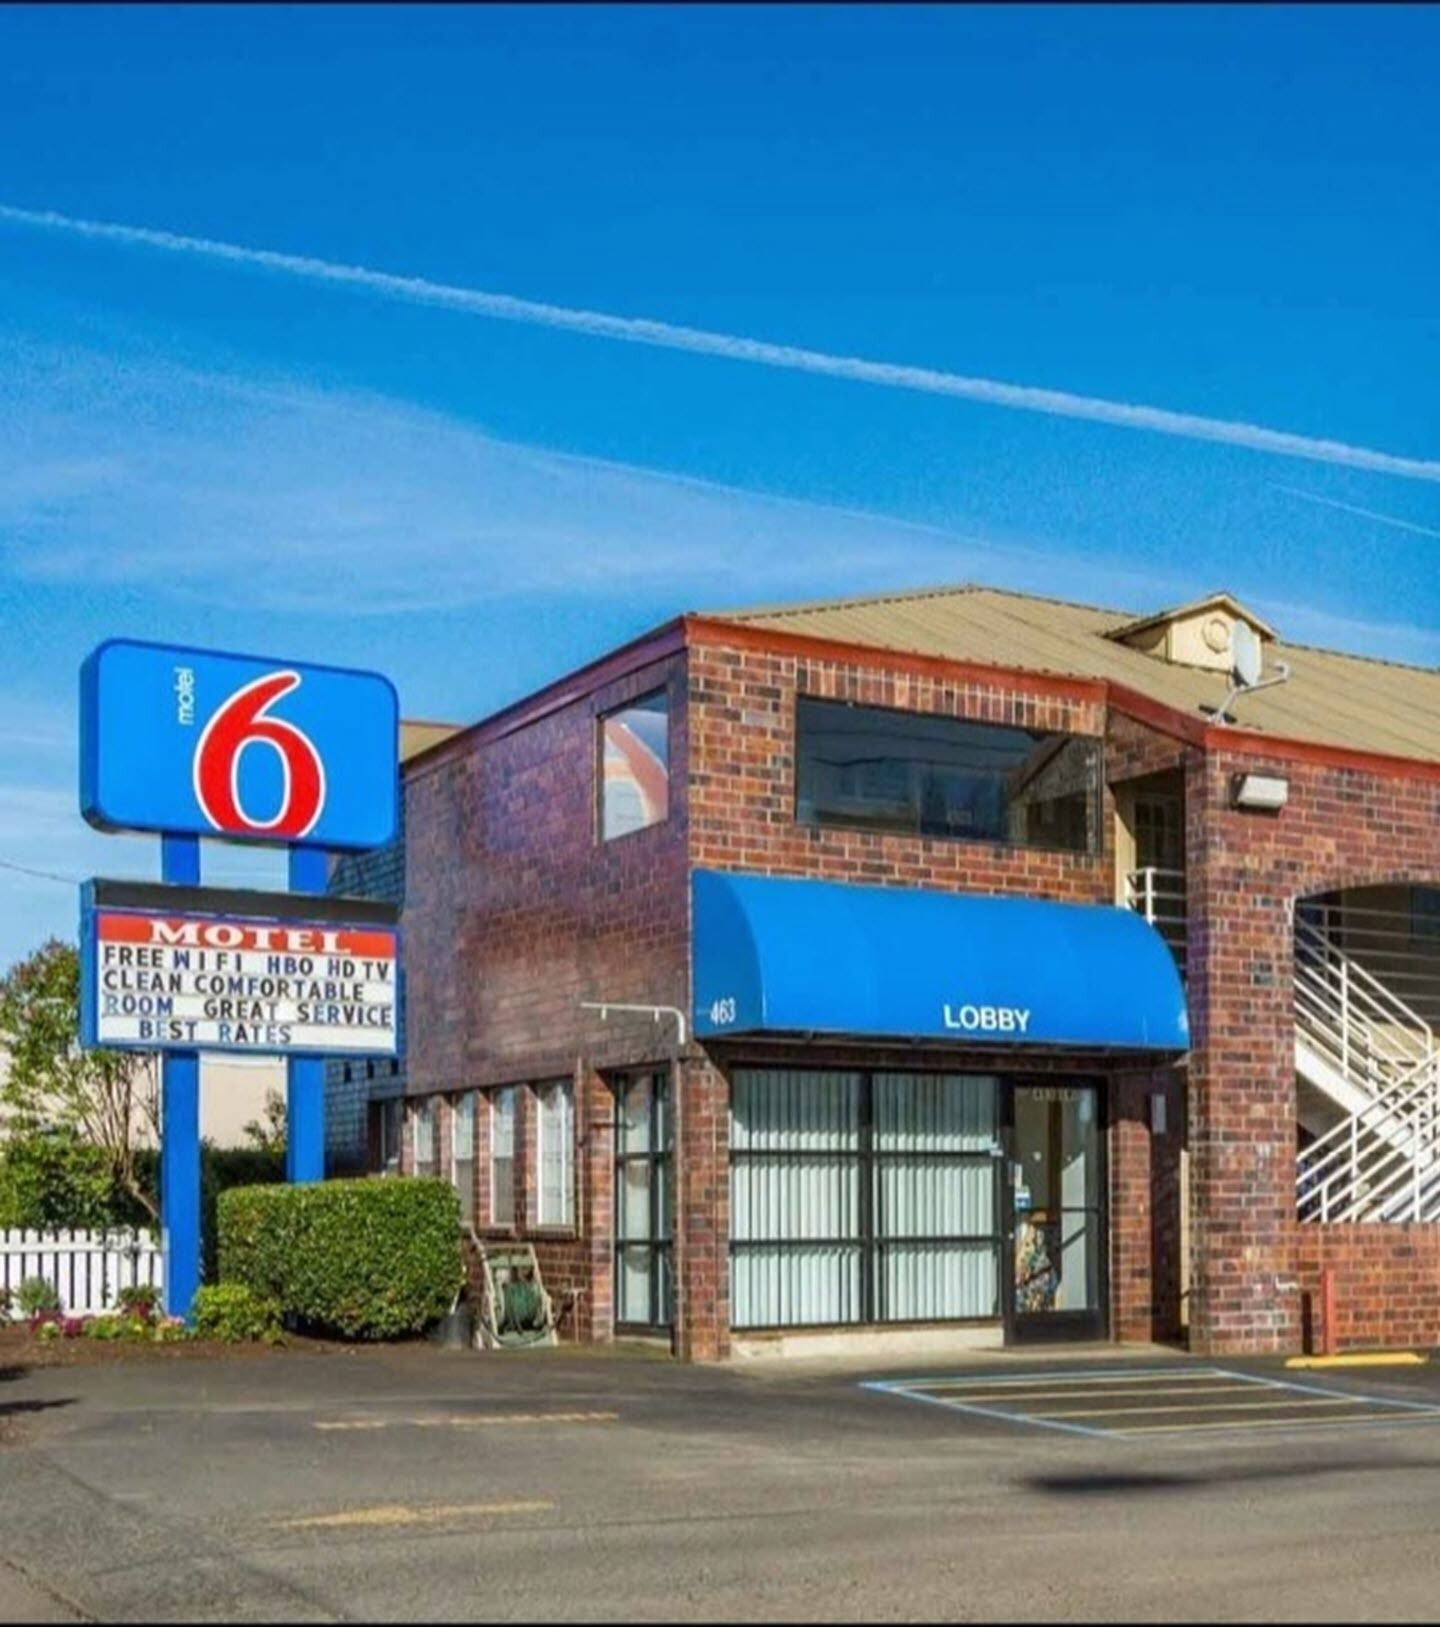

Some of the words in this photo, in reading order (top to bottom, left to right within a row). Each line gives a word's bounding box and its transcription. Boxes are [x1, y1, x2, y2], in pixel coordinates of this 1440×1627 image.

[175, 667, 194, 725] motel
[193, 670, 326, 838] 6
[151, 920, 352, 954] MOTEL
[104, 946, 164, 968] FREE
[267, 956, 314, 976] HBO
[104, 970, 182, 993] CLEAN
[194, 974, 364, 1002] COMFORTABLE
[105, 994, 174, 1016] ROOM
[203, 998, 279, 1021] GREAT
[298, 1003, 392, 1027] SERVICE
[710, 998, 736, 1026] 463
[943, 1004, 1031, 1032] LOBBY
[139, 1020, 198, 1041] BEST
[218, 1024, 292, 1045] RATES
